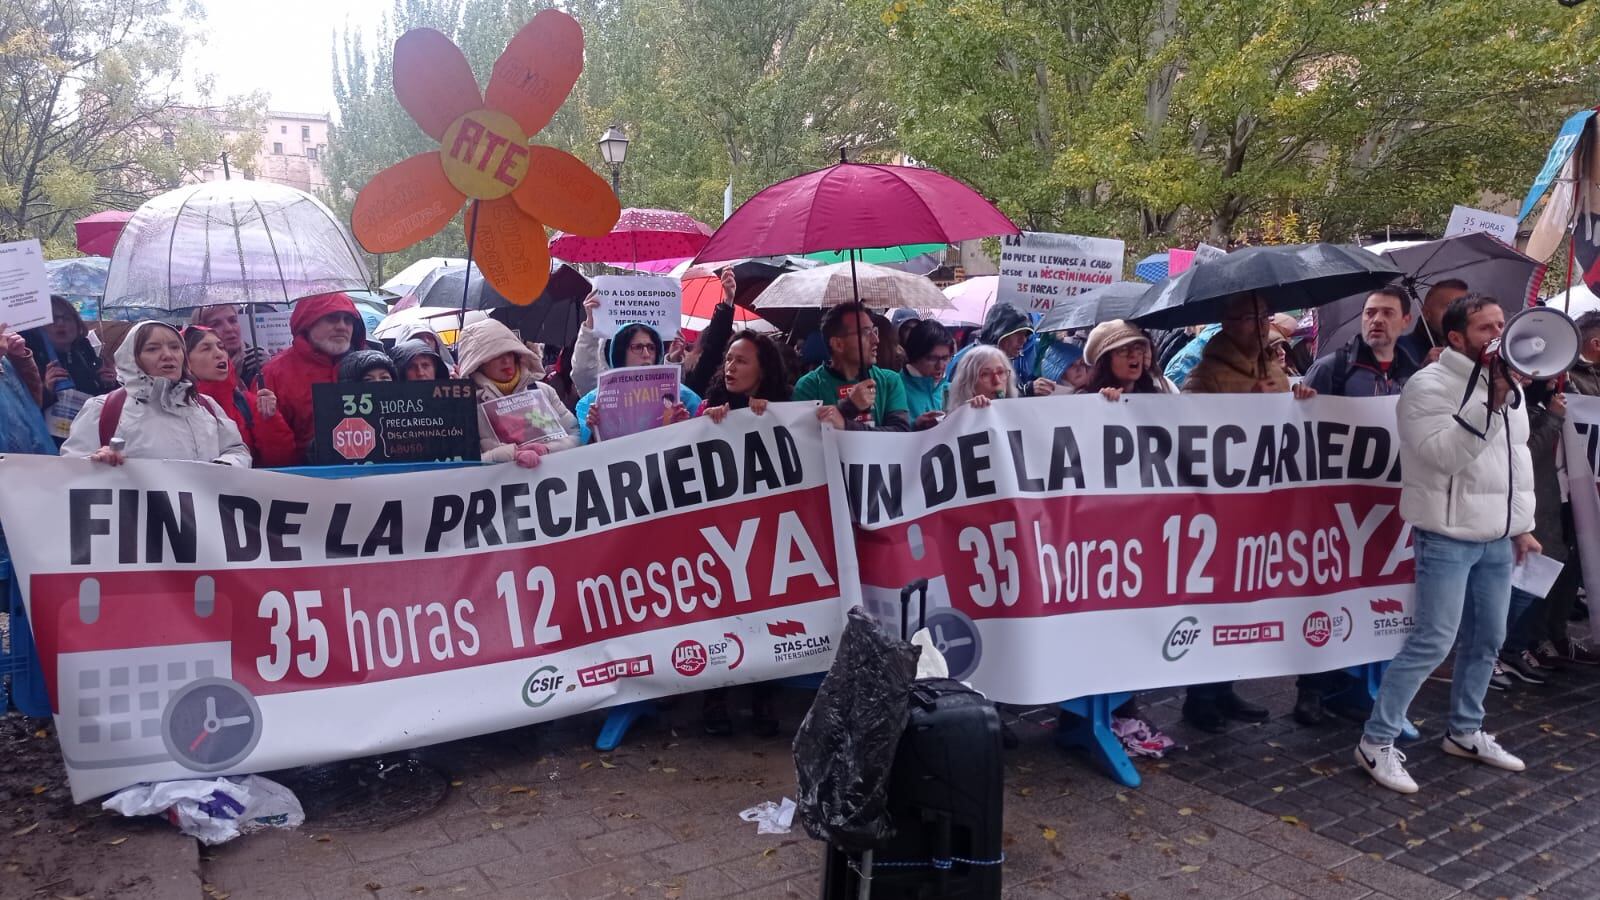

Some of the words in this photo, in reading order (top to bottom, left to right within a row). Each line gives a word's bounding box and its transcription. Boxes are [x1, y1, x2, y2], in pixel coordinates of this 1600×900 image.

[449, 118, 528, 188] ATE
[1464, 216, 1476, 226] 35
[1480, 221, 1505, 233] HORAS
[1005, 234, 1021, 247] LA
[1013, 254, 1036, 263] PUEDE
[1039, 255, 1078, 266] LLEVARSE
[1079, 258, 1087, 268] A
[1090, 259, 1113, 270] CABO
[1002, 268, 1023, 278] DESDE
[1028, 270, 1038, 279] LA
[598, 289, 610, 297] NO
[637, 290, 677, 298] DESPIDOS
[1017, 283, 1029, 293] 35
[1030, 283, 1059, 295] HORAS
[433, 385, 472, 399] ATES
[341, 394, 374, 416] 35
[379, 399, 424, 414] HORAS
[386, 417, 445, 428] PRECARIEDAD
[336, 430, 373, 447] STOP
[387, 427, 464, 440] DISCRIMINACIÓN
[920, 431, 997, 509] DE
[1007, 426, 1086, 493] LA
[69, 488, 197, 565] FIN
[218, 494, 309, 562] DE
[325, 499, 404, 560] LA
[424, 425, 804, 553] PRECARIEDAD
[958, 520, 1020, 608] 35
[1033, 520, 1143, 604] horas
[1162, 513, 1218, 595] 12
[1234, 525, 1343, 593] meses
[256, 589, 329, 682] 35
[343, 588, 480, 673] horas
[496, 565, 563, 649] 12
[576, 551, 722, 635] meses
[699, 510, 835, 603] YA
[1306, 616, 1330, 630] UGT
[1171, 628, 1201, 646] CSIF
[1216, 627, 1260, 642] CCOO
[675, 644, 702, 660] UGT
[774, 635, 830, 654] STAS-CLM
[775, 645, 832, 662] INTERSINDICAL
[582, 661, 627, 684] CCOO
[530, 675, 564, 693] CSIF
